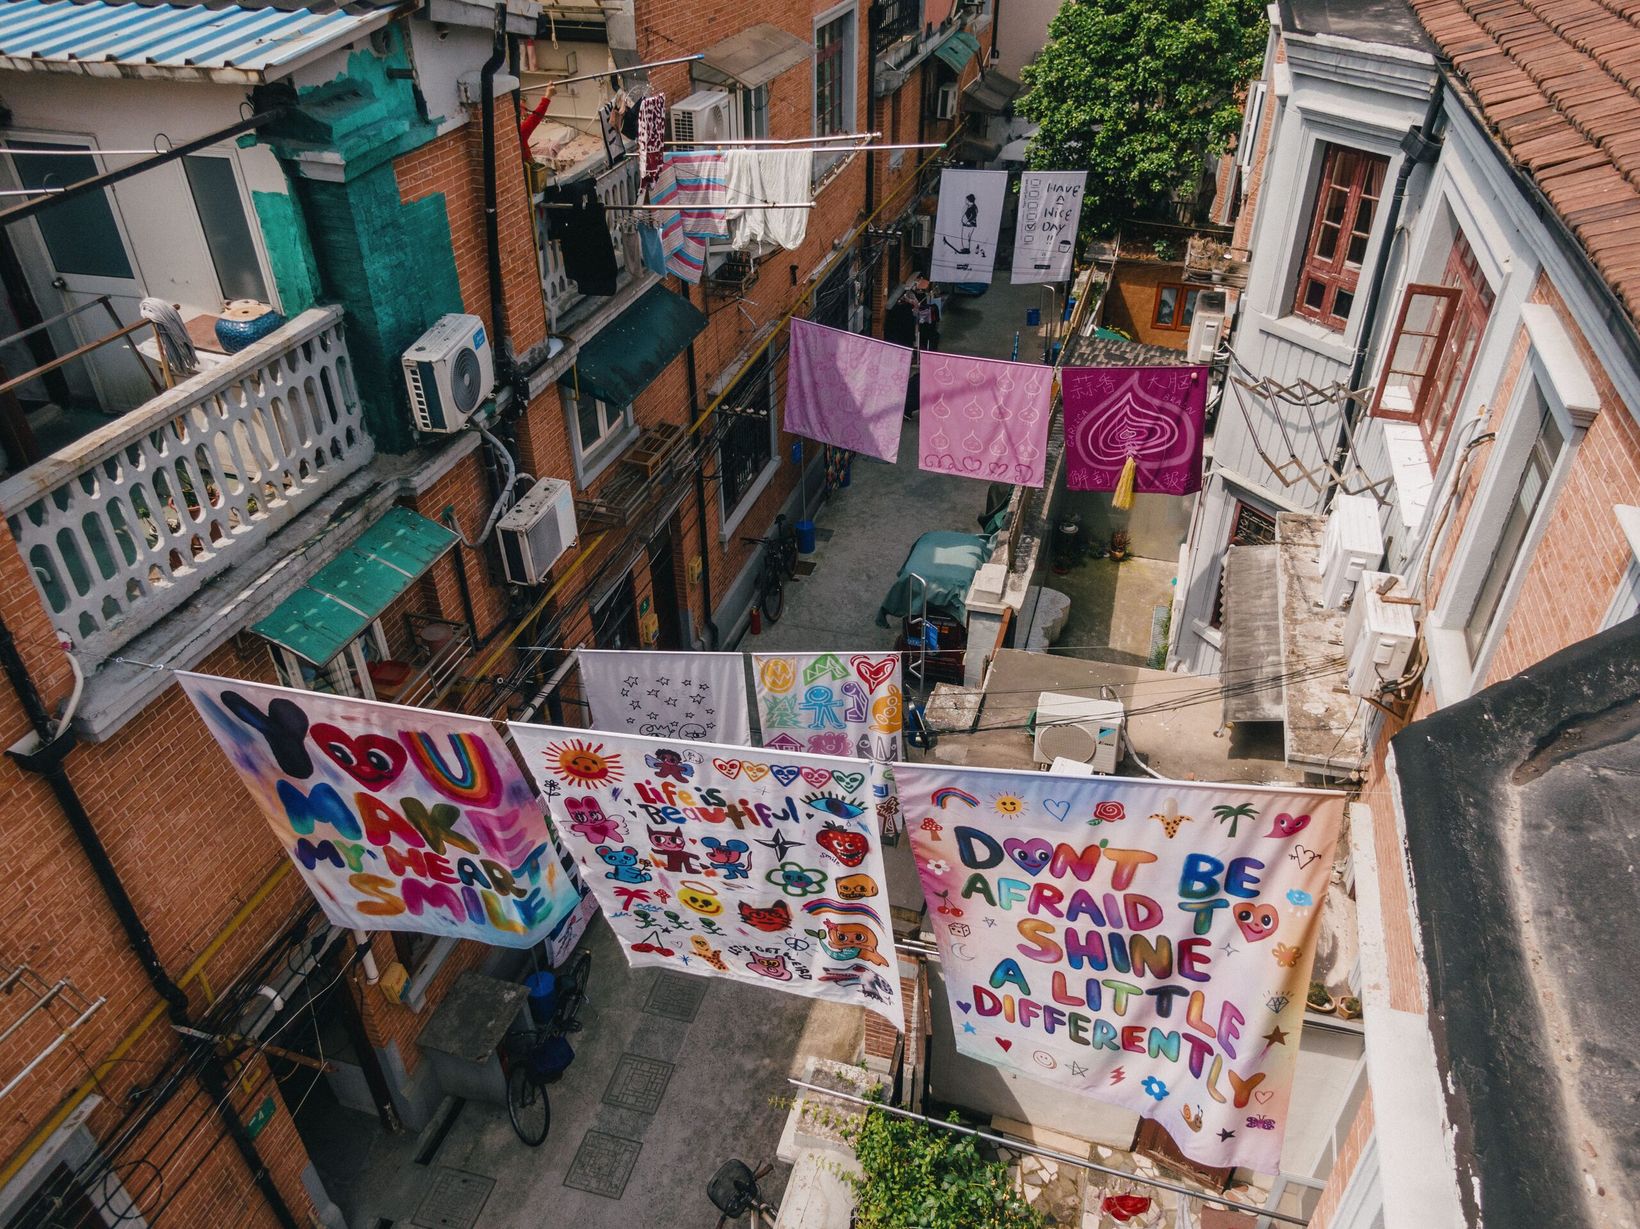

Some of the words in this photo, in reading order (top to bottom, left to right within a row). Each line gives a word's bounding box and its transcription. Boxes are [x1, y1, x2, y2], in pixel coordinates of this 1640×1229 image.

[1047, 183, 1081, 198] HAVE
[1042, 221, 1066, 236] DAY
[634, 779, 696, 806] Life
[694, 786, 726, 807] is
[637, 796, 799, 830] Beautiful
[276, 779, 535, 869] MAKE
[382, 842, 548, 899] HEART
[1178, 852, 1266, 899] BE
[348, 873, 555, 936] SMILE
[961, 872, 1163, 931] AFRAID
[1016, 918, 1212, 983] SHINE
[989, 957, 1031, 996] A
[1051, 970, 1246, 1060] LITTLE
[972, 984, 1266, 1109] DIFFERENTLY
